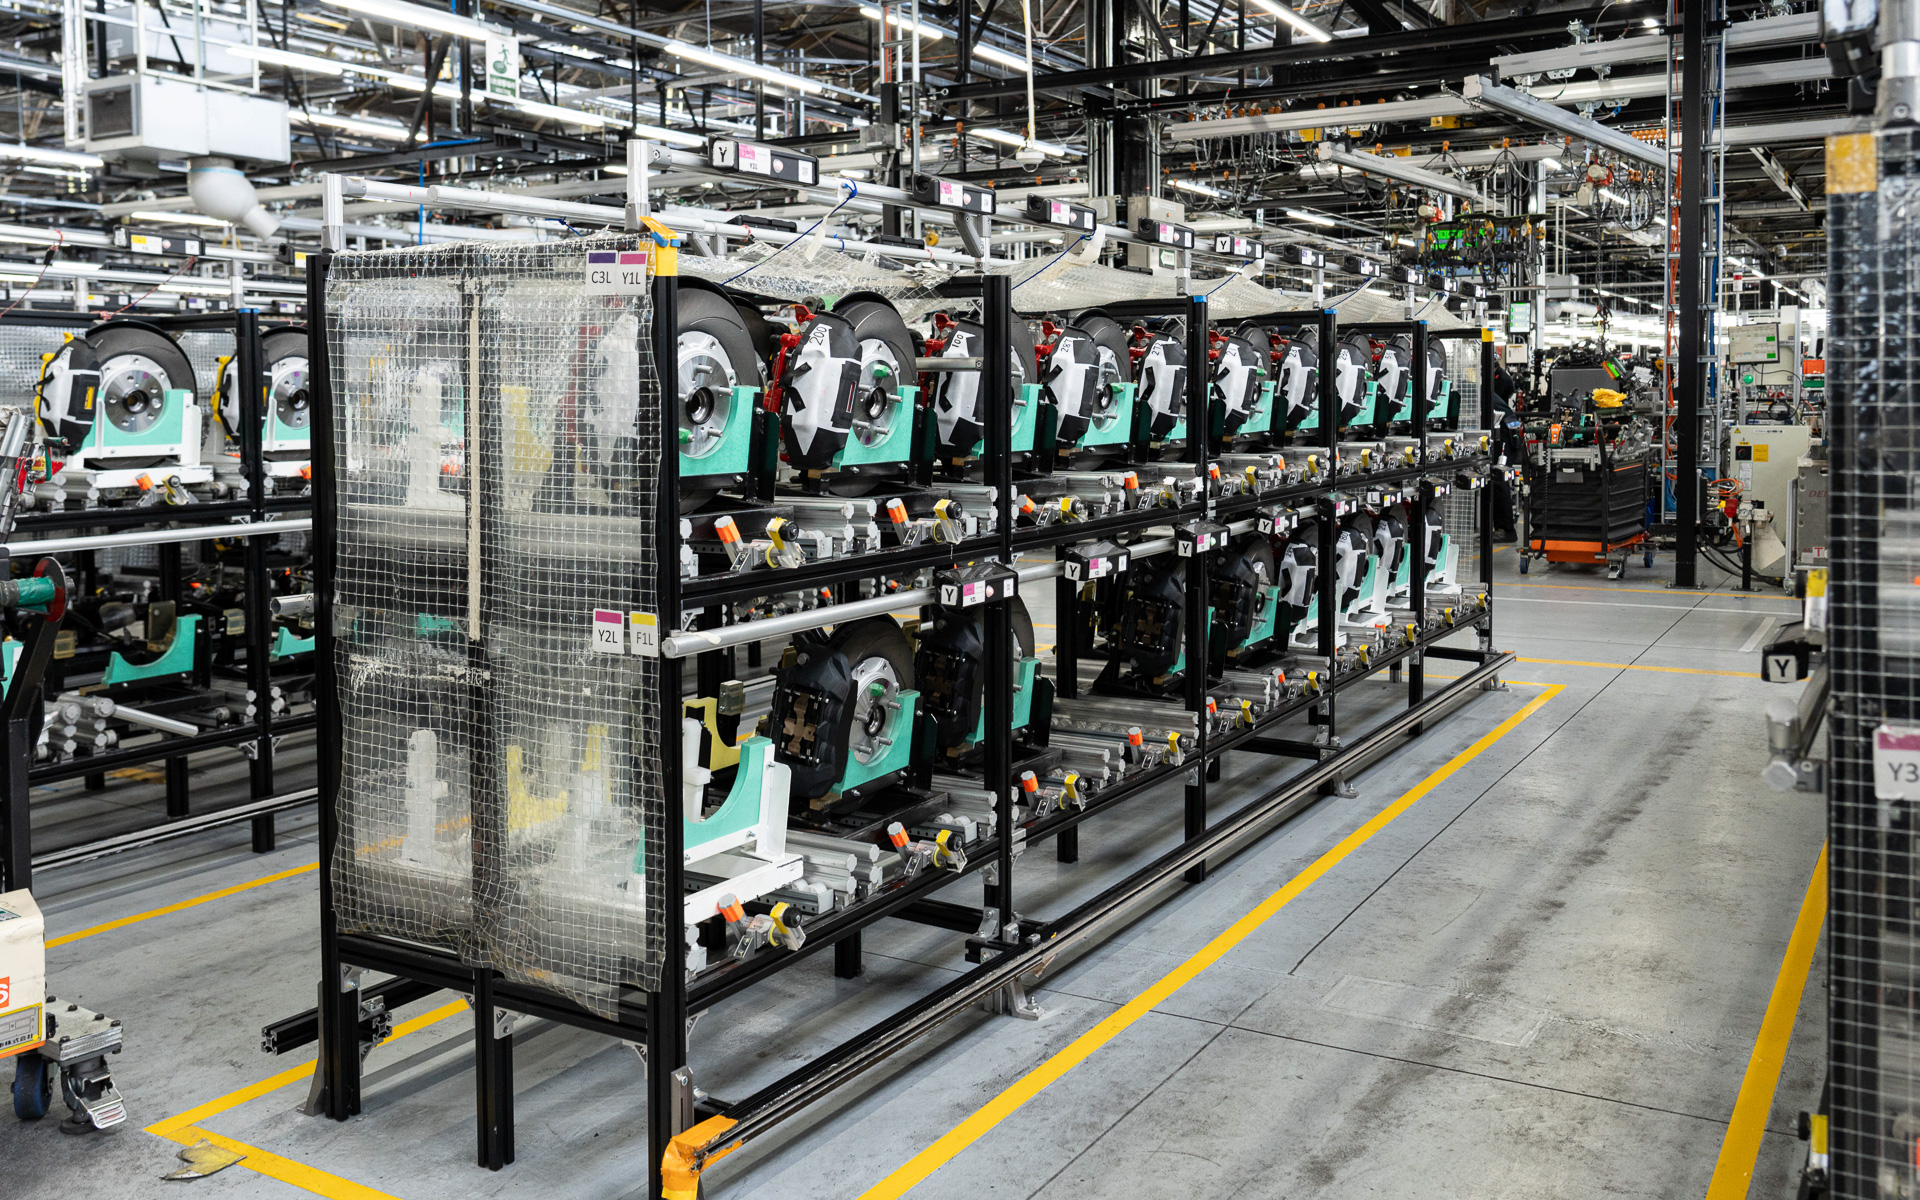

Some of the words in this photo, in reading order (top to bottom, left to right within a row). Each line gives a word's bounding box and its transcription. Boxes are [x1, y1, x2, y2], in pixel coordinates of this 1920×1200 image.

[718, 147, 728, 162] Y
[1220, 240, 1227, 250] Y
[591, 270, 612, 284] C3L
[622, 271, 641, 285] Y1L
[808, 326, 827, 346] 200
[1370, 493, 1377, 503] L
[1262, 521, 1270, 531] Y
[1182, 543, 1190, 554] Y
[1813, 546, 1824, 558] T
[1069, 564, 1078, 578] Y
[945, 587, 955, 603] Y
[598, 629, 618, 644] Y2L
[636, 631, 654, 646] F1L
[1774, 658, 1790, 678] Y
[1888, 762, 1920, 783] Y3
